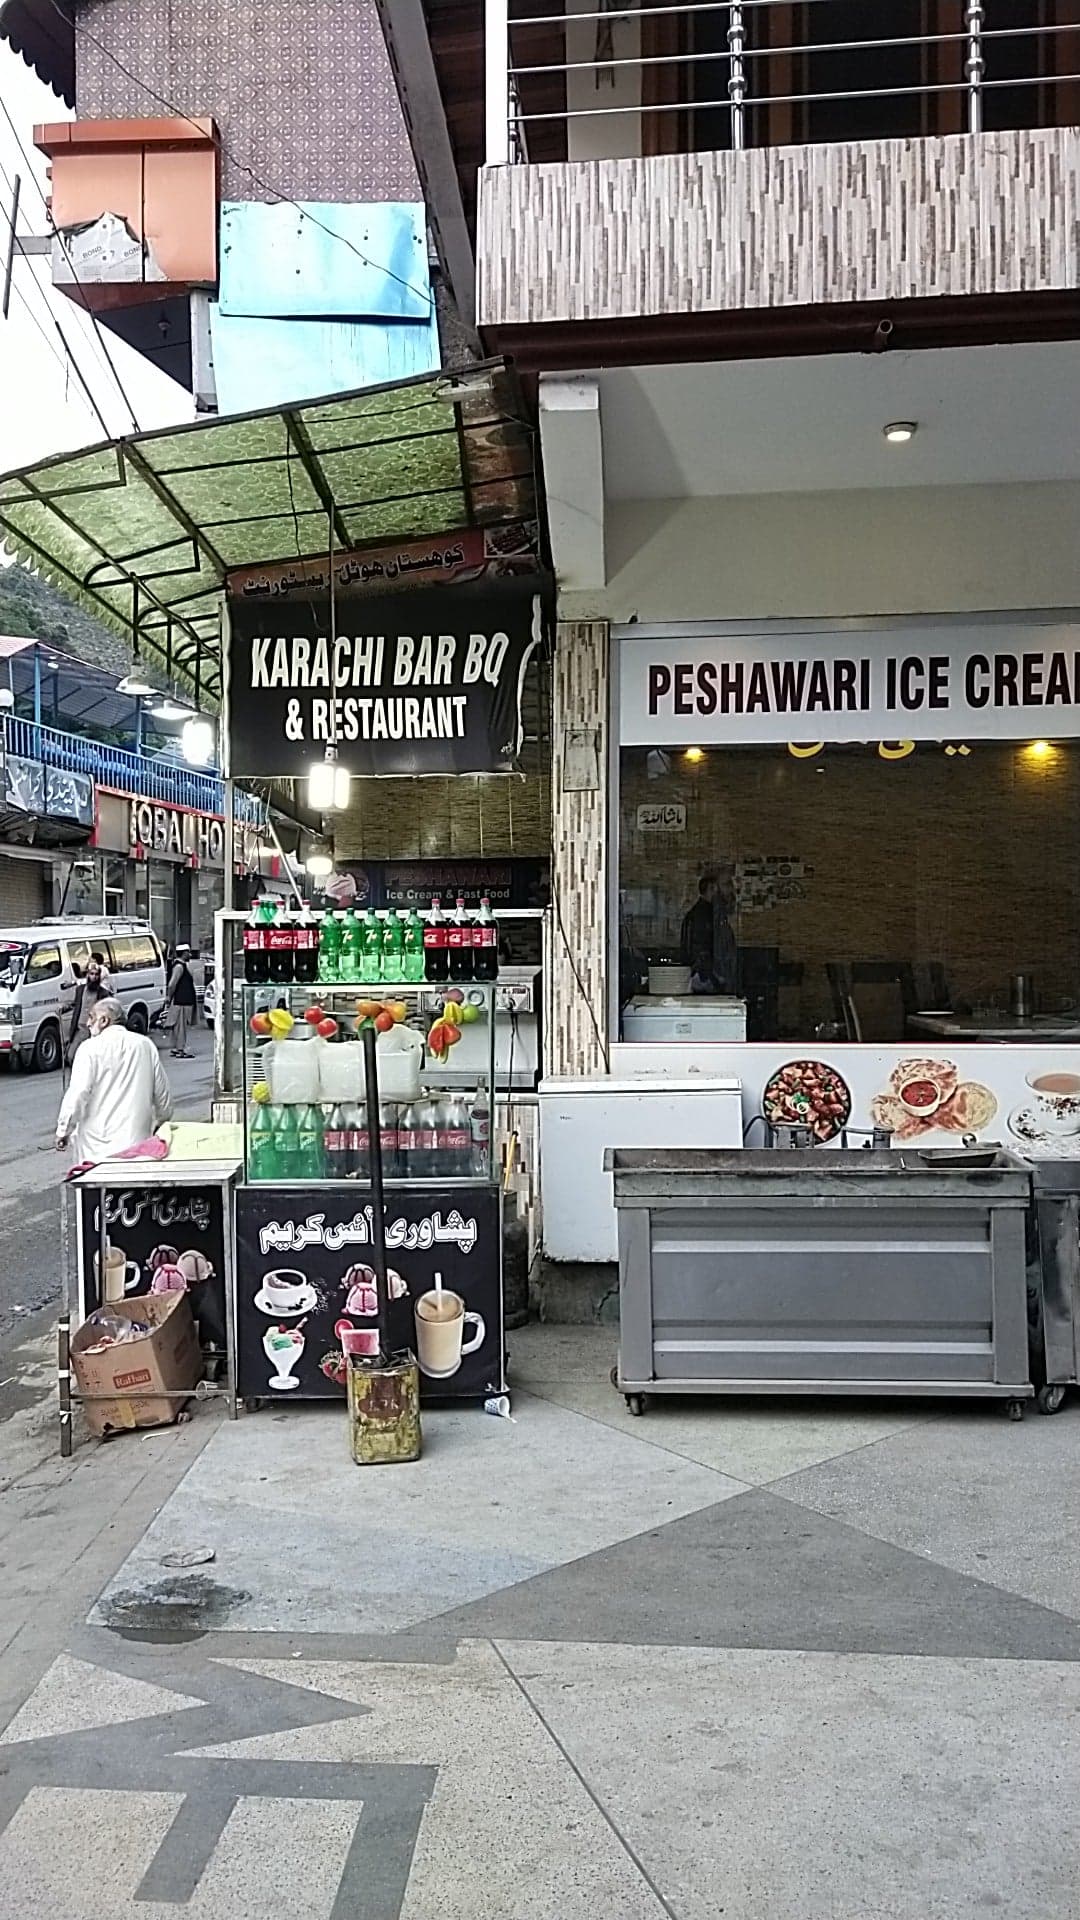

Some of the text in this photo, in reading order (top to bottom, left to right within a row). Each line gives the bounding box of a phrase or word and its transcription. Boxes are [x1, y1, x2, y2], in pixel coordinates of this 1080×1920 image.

[251, 632, 510, 688] KARACHI BAR BQ
[649, 651, 1080, 715] PESHAWARI ICE CREA
[285, 695, 467, 740] & RESTAURANT
[130, 799, 250, 866] IQBAL HOEL
[386, 888, 510, 900] Ice Cream & Fast Food
[259, 1213, 326, 1255] کریم
[384, 1210, 478, 1254] پشاوری
